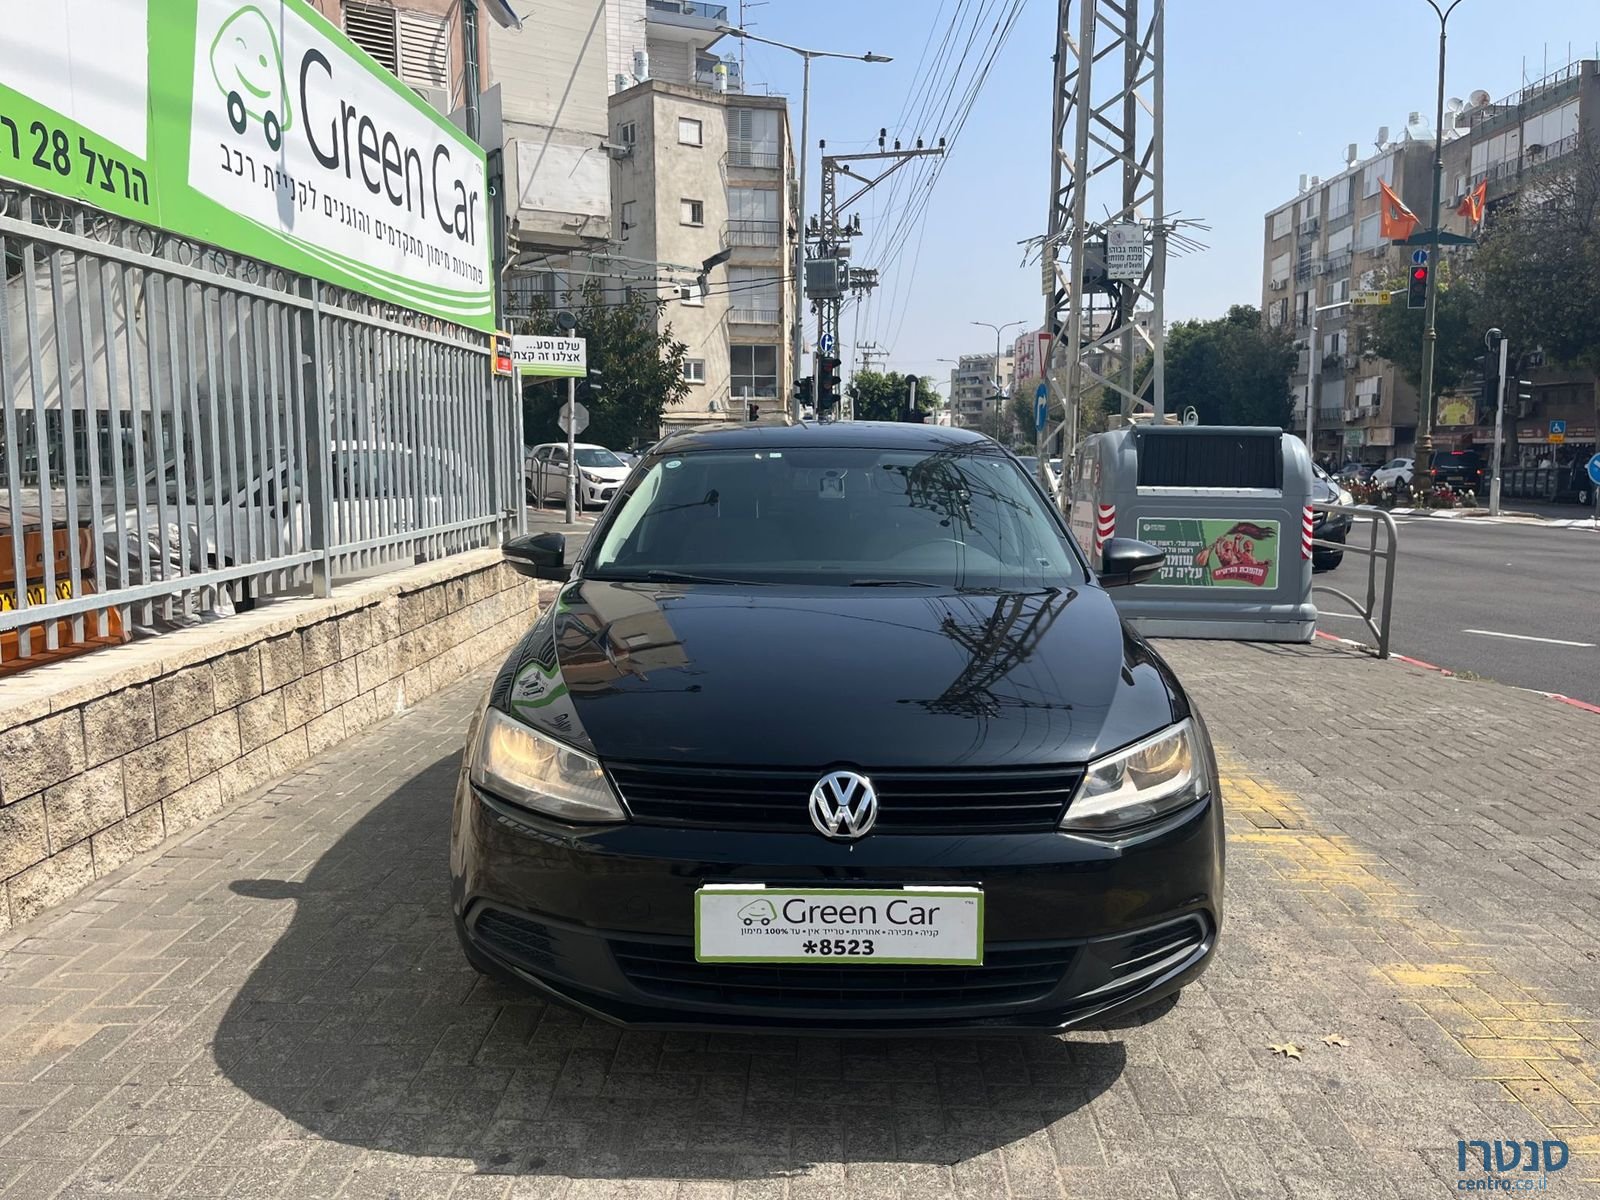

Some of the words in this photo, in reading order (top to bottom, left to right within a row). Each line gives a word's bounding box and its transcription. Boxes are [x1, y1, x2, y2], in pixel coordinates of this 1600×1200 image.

[30, 121, 71, 176] 28
[299, 48, 425, 220] Green
[432, 143, 478, 246] Car
[79, 136, 149, 205] הרצל
[220, 143, 256, 182] רכב
[263, 164, 316, 212] לקניית
[323, 194, 370, 234] והוגנים
[375, 219, 423, 259] מתקדמים
[427, 243, 450, 270] מימון
[452, 256, 483, 285] פתרונות
[513, 350, 535, 362] קצת
[526, 340, 554, 350] וסע...
[538, 351, 549, 361] זה
[552, 351, 580, 362] אצלנו
[557, 340, 580, 351] שלם
[1165, 554, 1193, 566] שומר
[782, 898, 877, 924] Green
[886, 899, 940, 925] Car
[741, 928, 762, 936] מימון
[807, 928, 820, 936] אין
[920, 929, 939, 938] קניה
